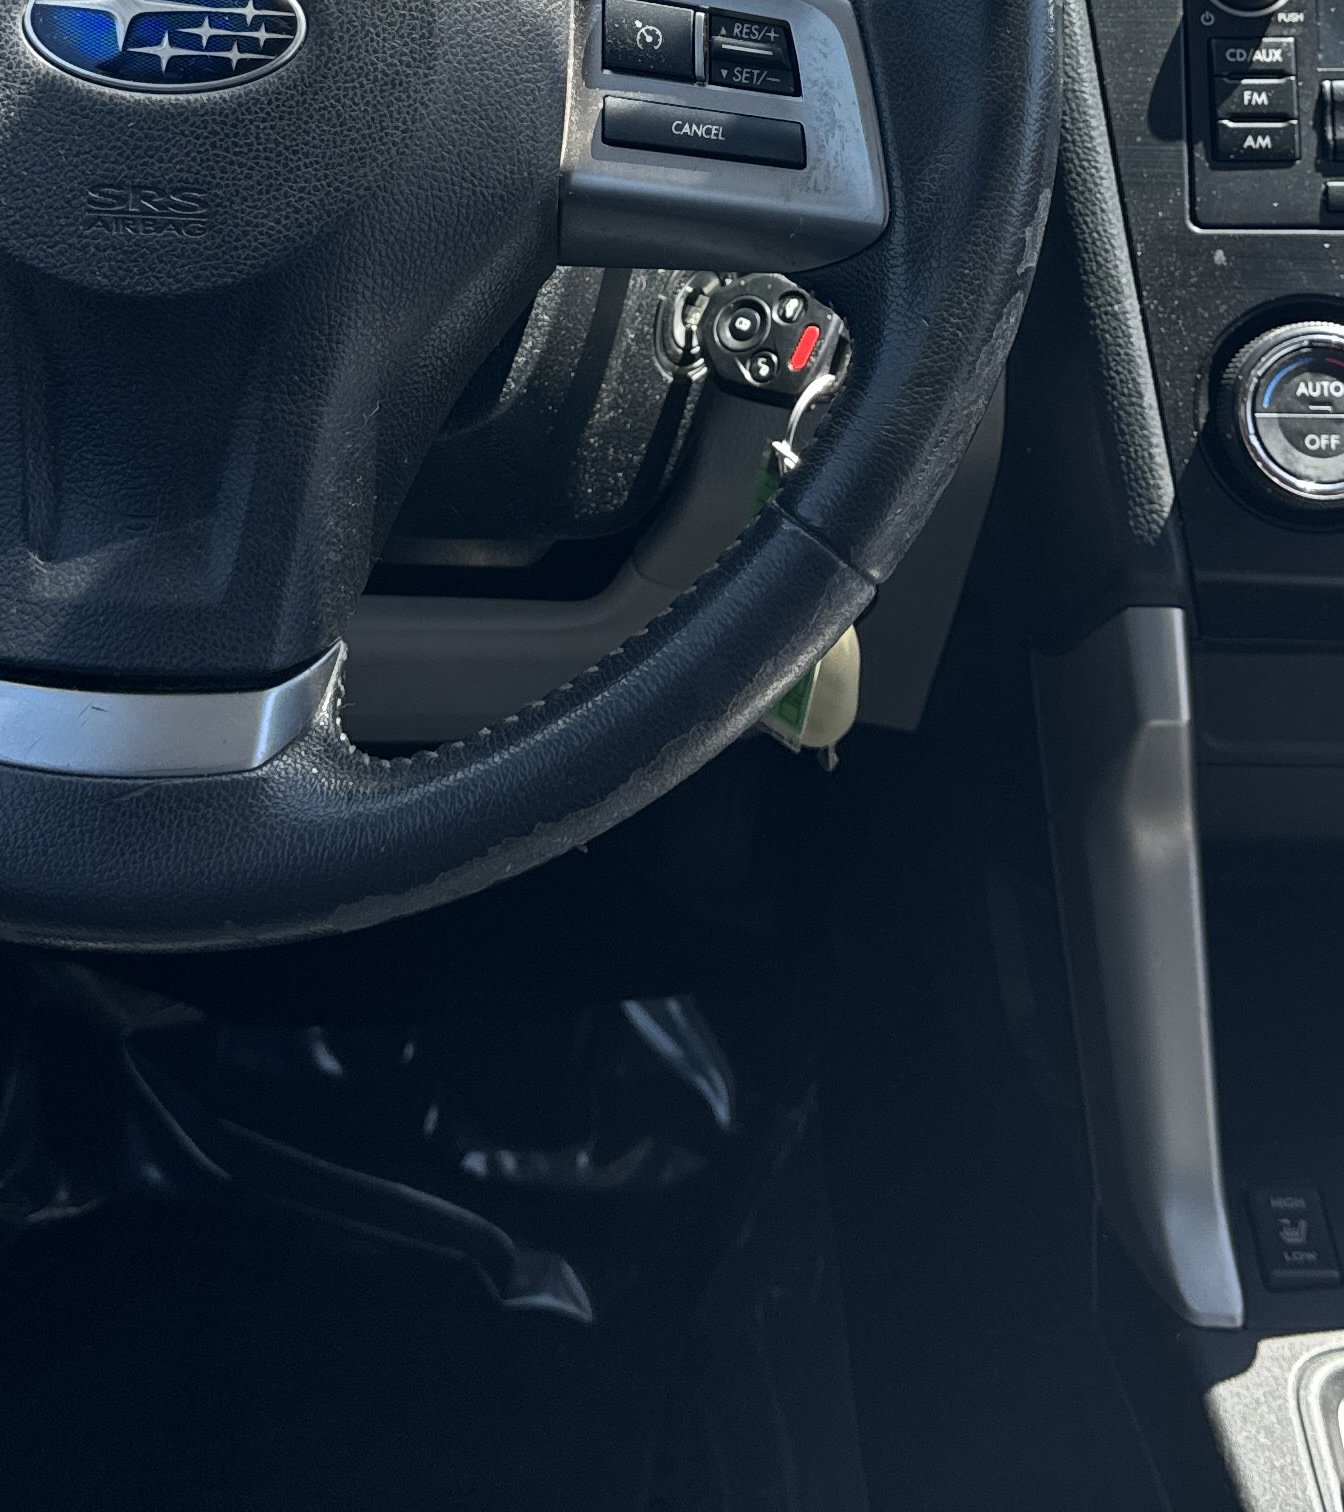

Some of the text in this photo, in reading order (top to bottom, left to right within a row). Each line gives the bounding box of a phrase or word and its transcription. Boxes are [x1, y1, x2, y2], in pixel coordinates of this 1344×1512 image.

[1278, 12, 1304, 23] PUSH
[1226, 47, 1283, 63] CD/AUX
[1243, 90, 1269, 106] FM
[672, 120, 726, 142] CANCEL
[1243, 134, 1272, 150] AM
[87, 184, 211, 214] SRS
[87, 217, 209, 238] AIRBAG
[1304, 433, 1341, 451] OFF
